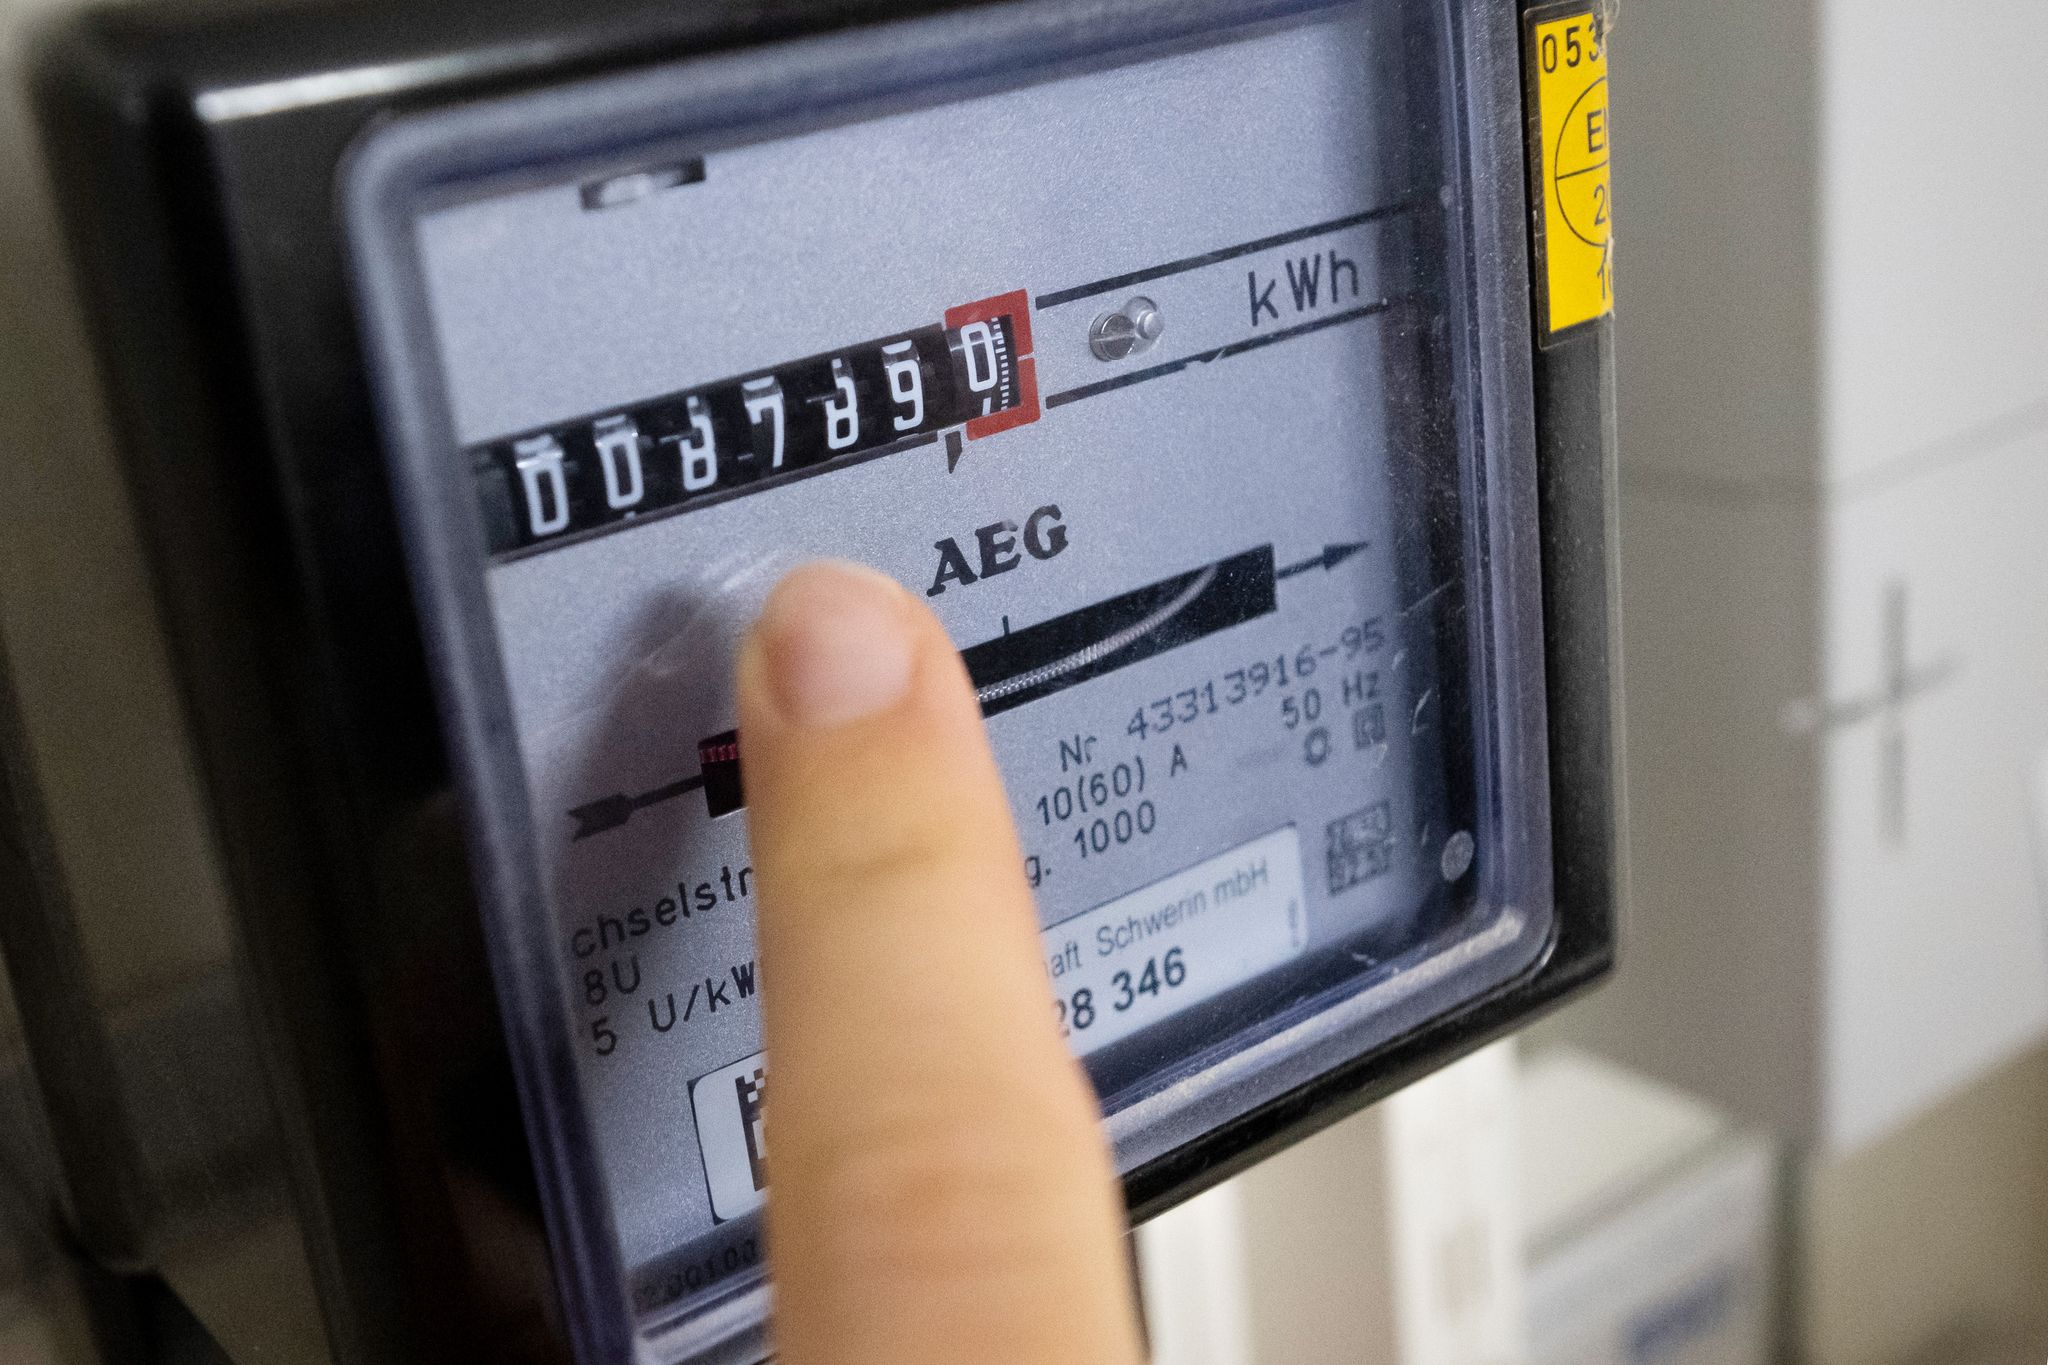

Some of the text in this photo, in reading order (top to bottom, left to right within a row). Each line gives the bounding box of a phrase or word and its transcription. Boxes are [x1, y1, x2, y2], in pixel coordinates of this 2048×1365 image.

[1587, 109, 1608, 154] E
[1594, 183, 1612, 226] 2
[1247, 250, 1359, 327] kWh
[927, 504, 1070, 597] AEG
[1058, 616, 1387, 772] Nr 43313916-95
[1035, 755, 1145, 826] 10(60)
[1170, 743, 1189, 778] A
[1280, 687, 1323, 730] 50
[1073, 800, 1157, 859] 1000
[1095, 890, 1208, 958] Schwerin
[1213, 859, 1271, 907] mbH
[1111, 945, 1188, 1012] 346
